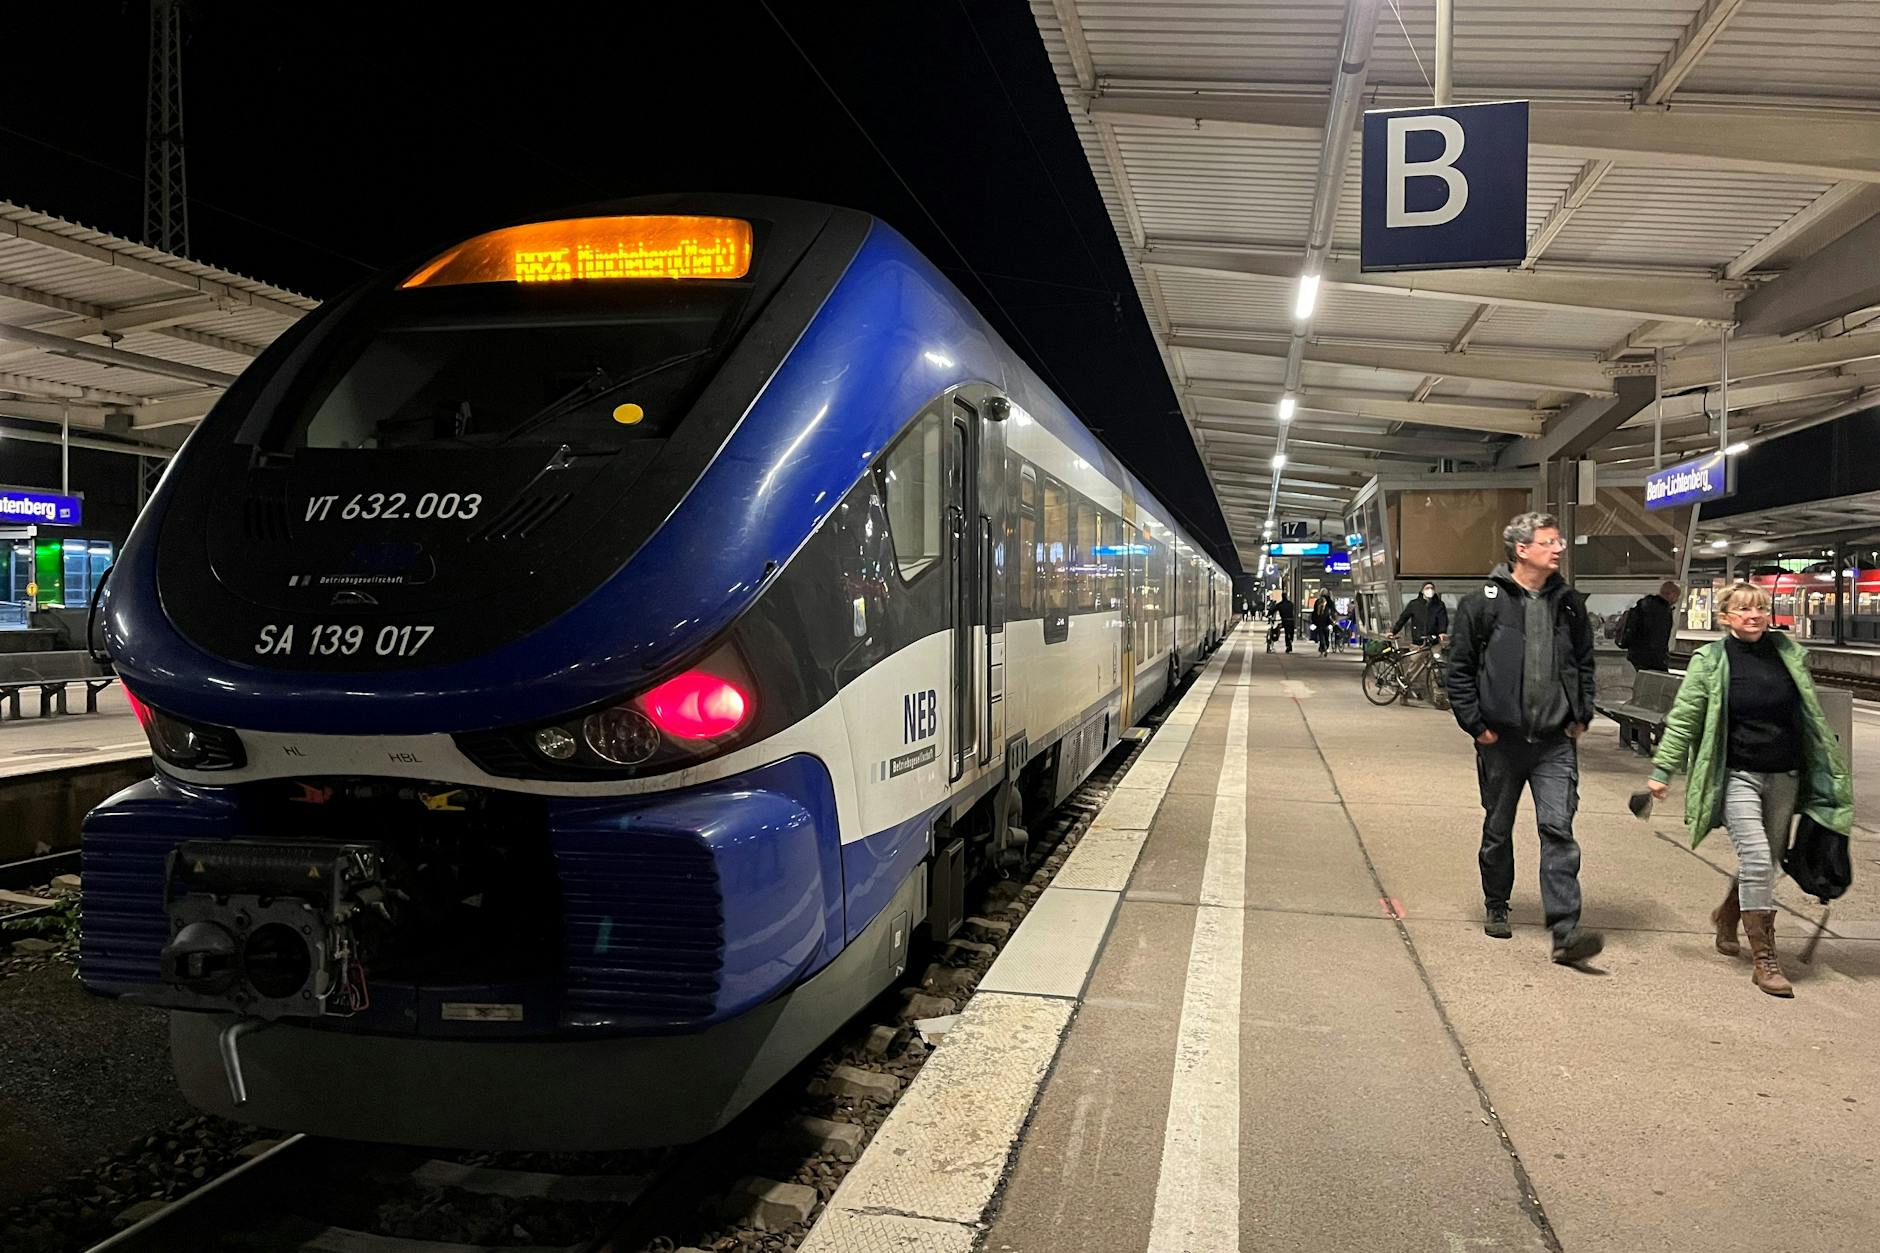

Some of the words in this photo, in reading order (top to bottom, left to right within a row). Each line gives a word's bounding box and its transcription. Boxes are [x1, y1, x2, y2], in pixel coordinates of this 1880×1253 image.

[1386, 115, 1469, 228] B
[1646, 468, 1709, 502] Berlin-Lichtenberg
[304, 496, 339, 521] VT
[341, 493, 482, 520] 632.003
[1283, 522, 1299, 535] 17
[1265, 564, 1275, 575] C
[254, 624, 295, 655] SA
[308, 624, 364, 656] 139
[375, 625, 435, 656] 017
[904, 689, 937, 745] NEB
[388, 752, 424, 763] HBL
